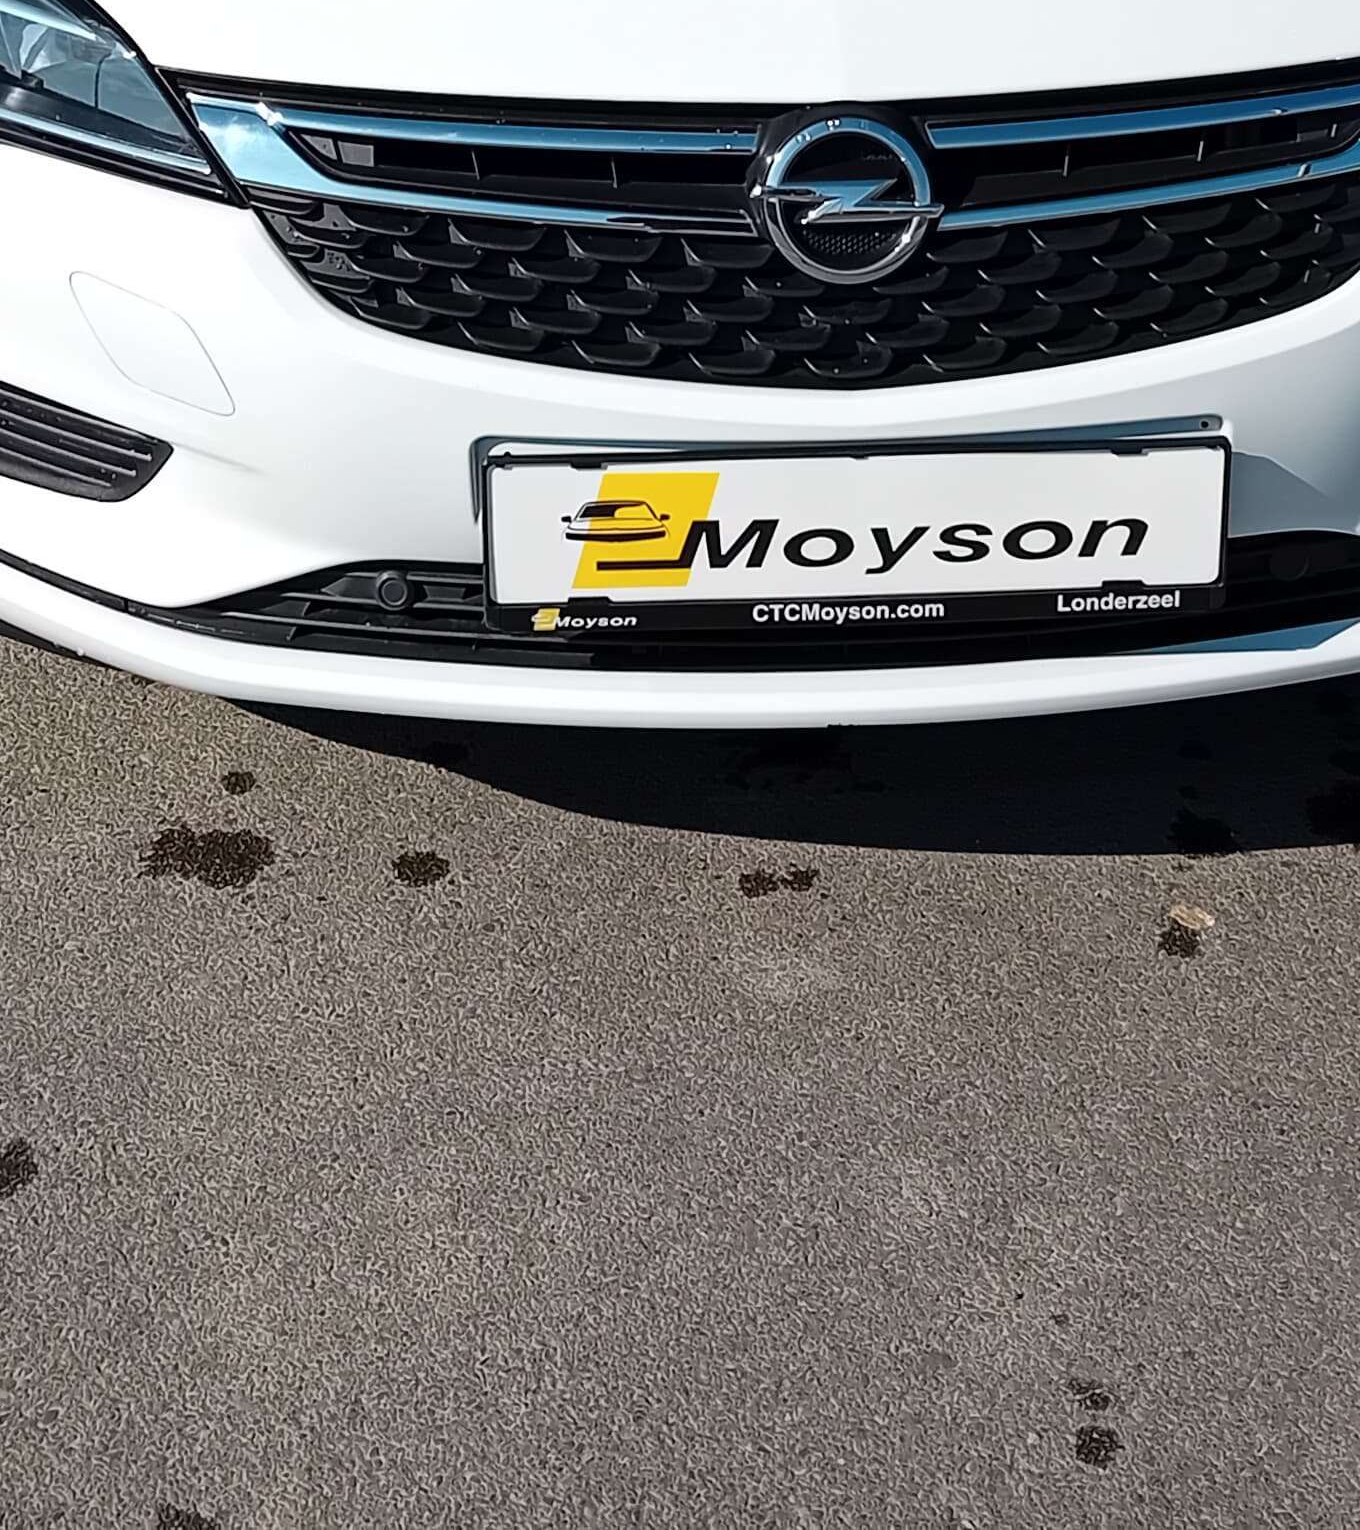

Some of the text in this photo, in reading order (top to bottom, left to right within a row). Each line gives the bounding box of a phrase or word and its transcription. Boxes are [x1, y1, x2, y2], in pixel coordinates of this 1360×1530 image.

[676, 517, 1151, 575] Moyson
[1056, 589, 1181, 612] Londerzeel
[555, 615, 638, 629] Moyson
[751, 602, 945, 625] CTCMoyson.com
